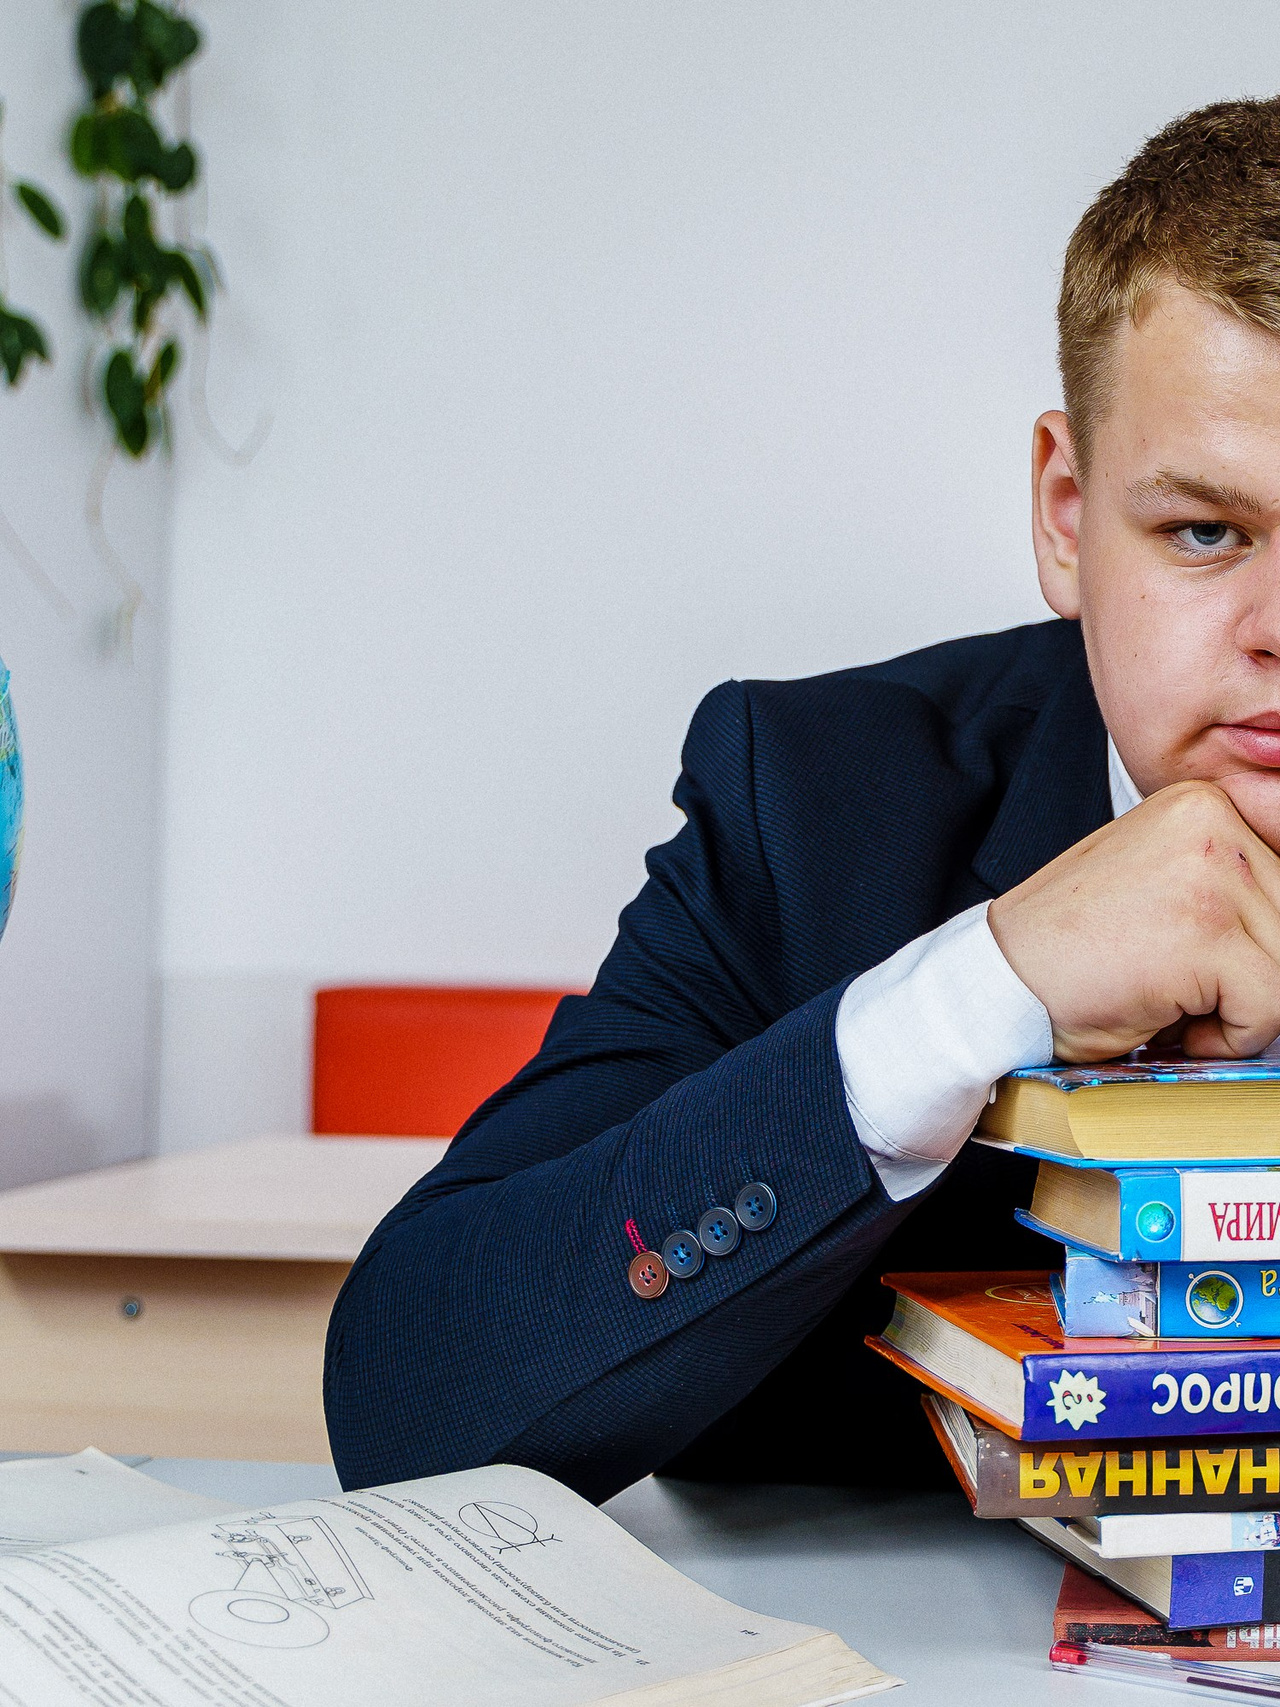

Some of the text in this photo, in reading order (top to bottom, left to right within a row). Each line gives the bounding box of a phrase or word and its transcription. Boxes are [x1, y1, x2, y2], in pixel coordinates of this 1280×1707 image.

[371, 1520, 418, 1557] увеличении
[416, 1555, 433, 1569] при
[454, 1542, 492, 1573] светового
[433, 1568, 469, 1598] дорожки
[442, 1560, 504, 1612] рассмотренного
[491, 1572, 511, 1589] хода
[493, 1561, 551, 1606] близорукости)
[511, 1589, 535, 1608] схема
[551, 1605, 568, 1617] или
[536, 1608, 574, 1634] показана
